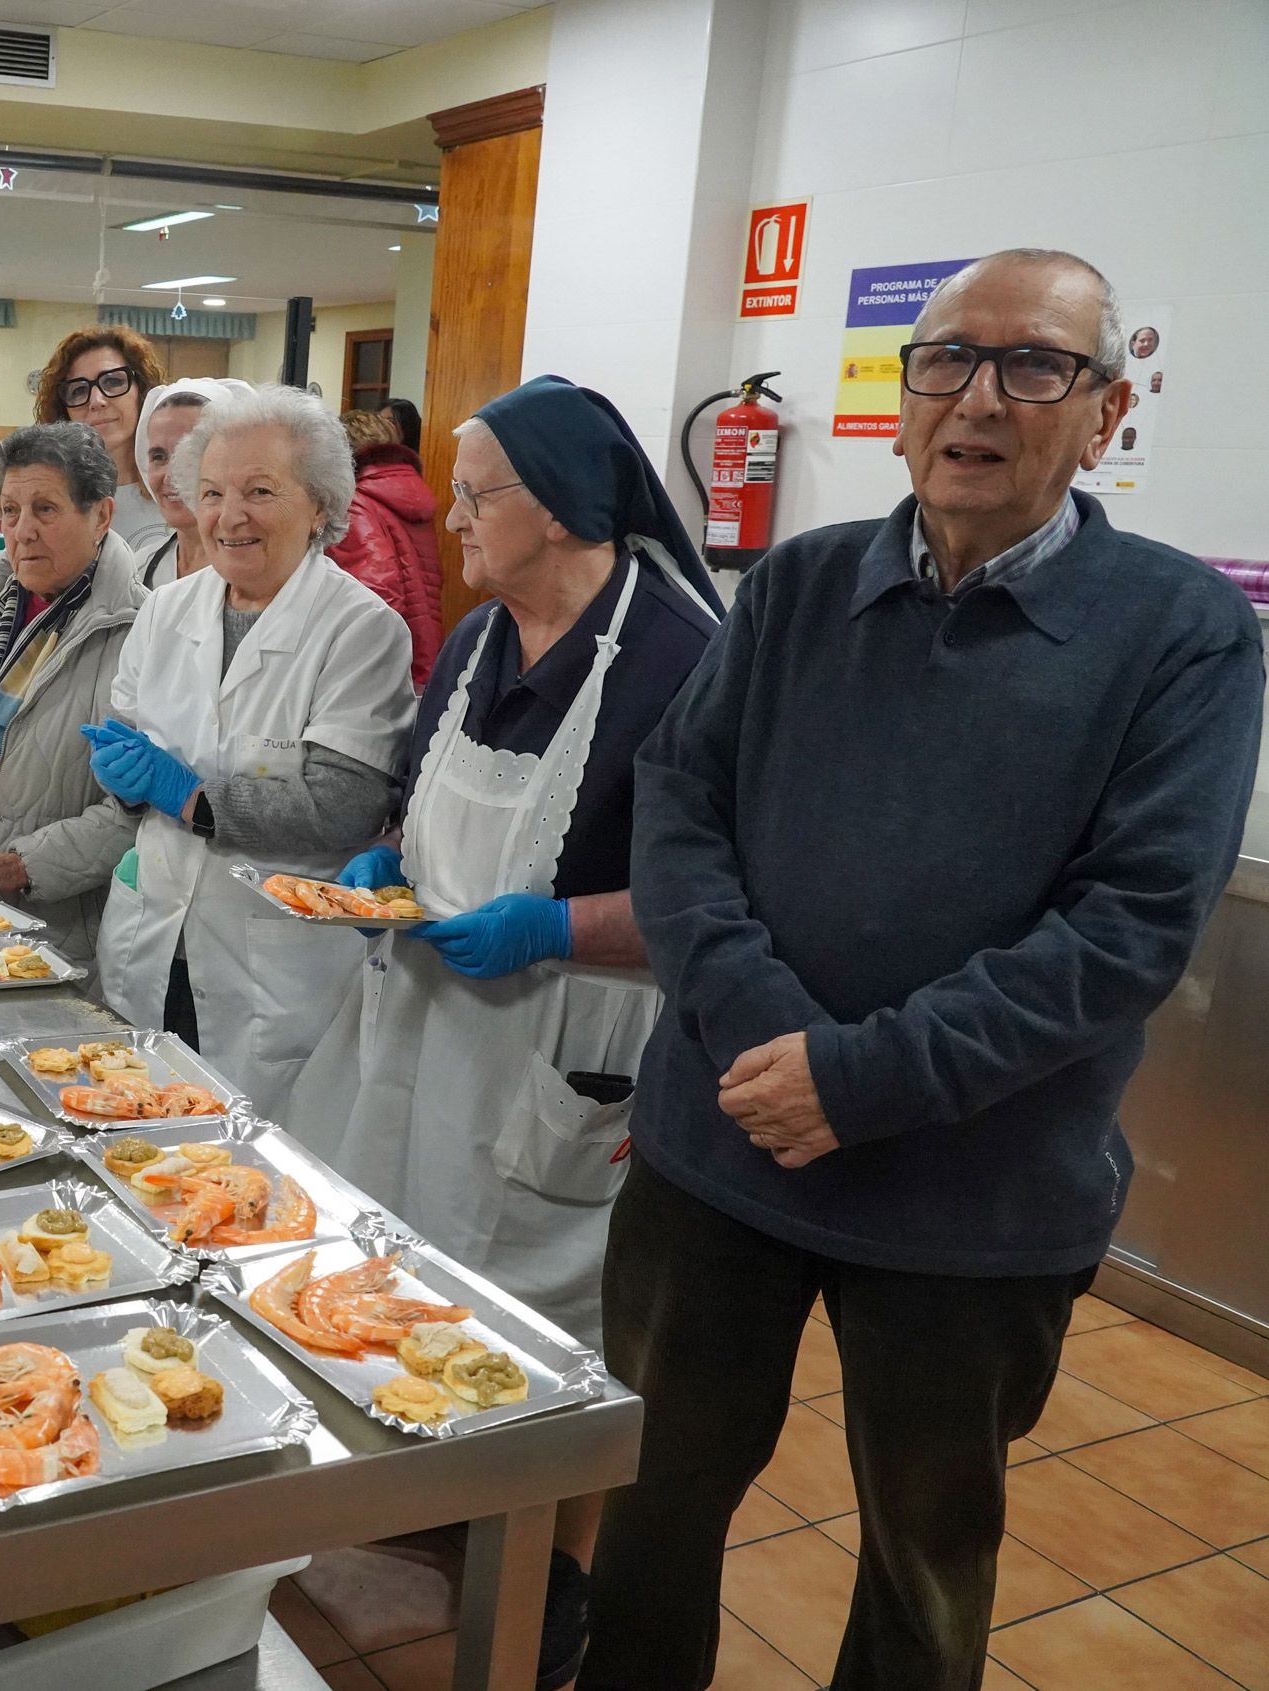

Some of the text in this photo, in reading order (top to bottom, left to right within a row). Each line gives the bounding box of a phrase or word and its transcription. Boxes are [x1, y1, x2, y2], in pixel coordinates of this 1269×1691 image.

[870, 280, 923, 292] PROGRAMA
[924, 279, 937, 288] DE
[745, 294, 792, 308] EXTINTOR
[857, 294, 906, 305] PERSONAS
[907, 291, 928, 302] MÁS
[837, 422, 877, 430] ALIMENTOS
[263, 738, 296, 750] JULIA
